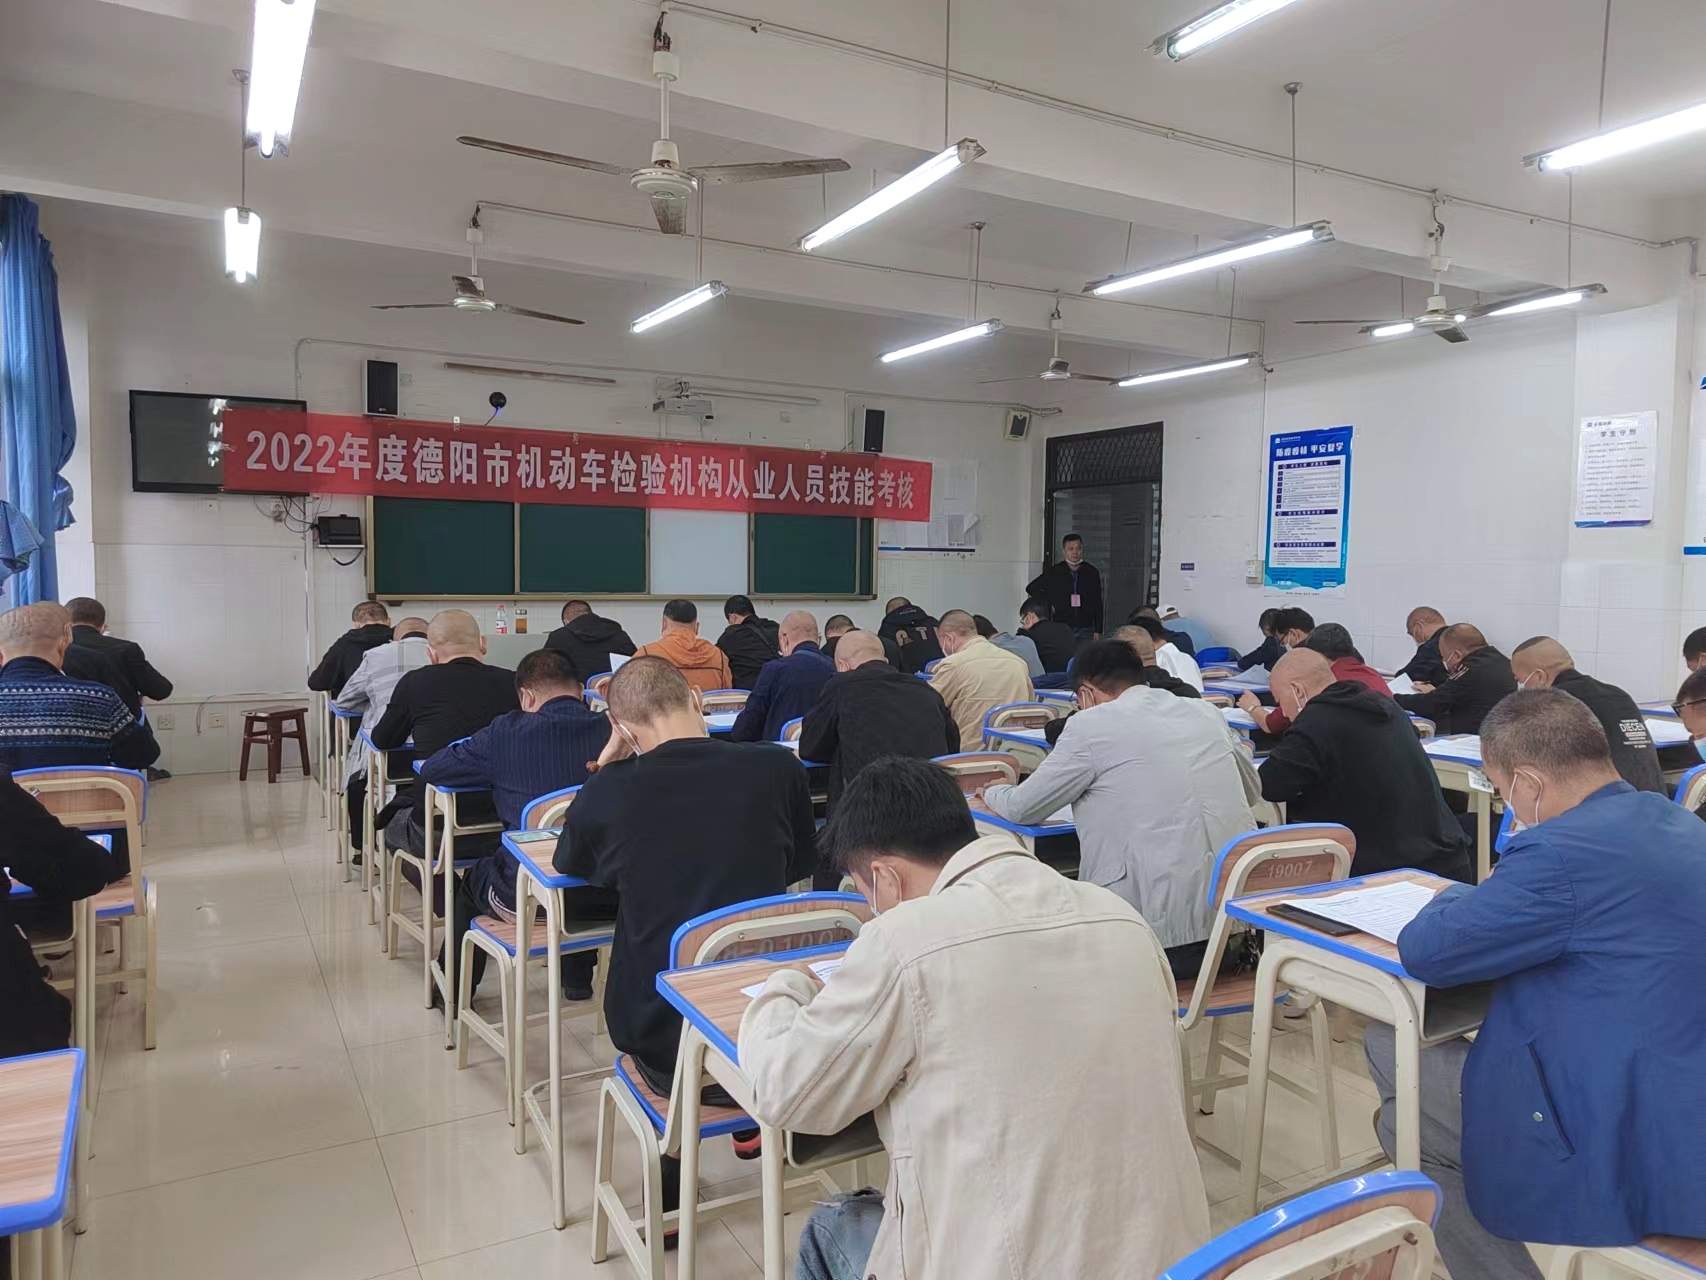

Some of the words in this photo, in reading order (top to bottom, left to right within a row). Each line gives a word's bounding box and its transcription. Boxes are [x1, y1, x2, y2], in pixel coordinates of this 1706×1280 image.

[246, 430, 913, 509] 2022年度德阳市机动车检验机构从业人员技能考核
[1268, 860, 1313, 879] 19007
